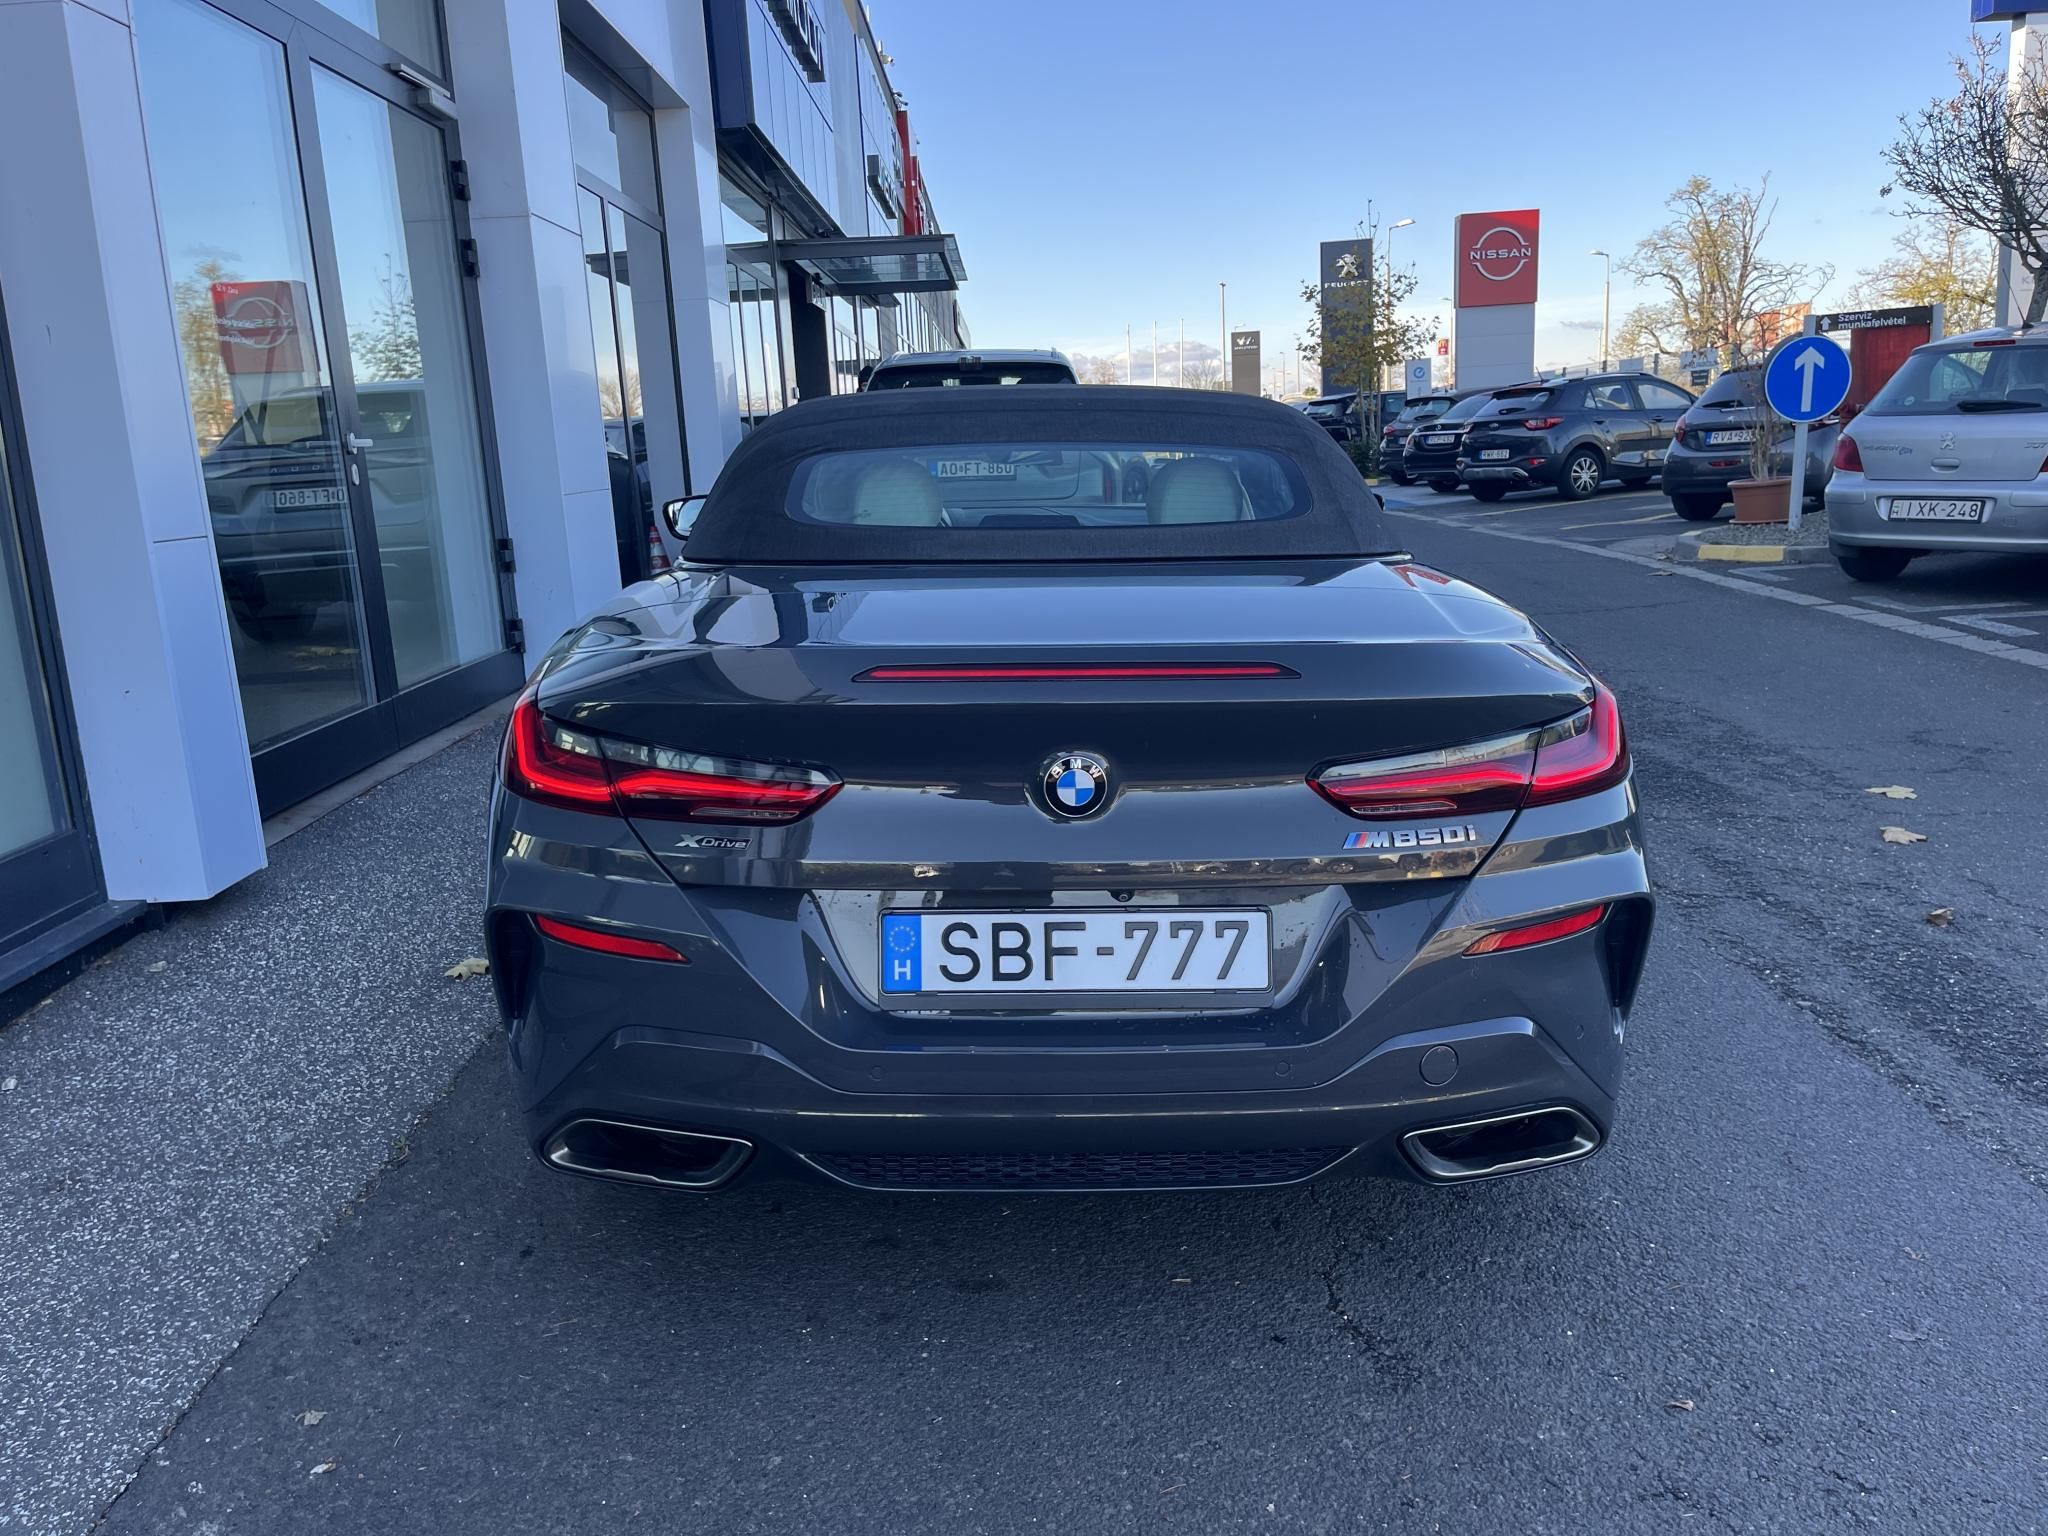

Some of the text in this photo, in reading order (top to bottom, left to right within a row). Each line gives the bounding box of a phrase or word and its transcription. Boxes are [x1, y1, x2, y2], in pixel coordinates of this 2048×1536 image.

[1470, 247, 1531, 260] NISSAN
[1838, 312, 1873, 322] Szerviz
[1906, 502, 1979, 518] IXK-248
[1051, 758, 1102, 779] BMW
[893, 920, 1250, 983] H SBF-777
